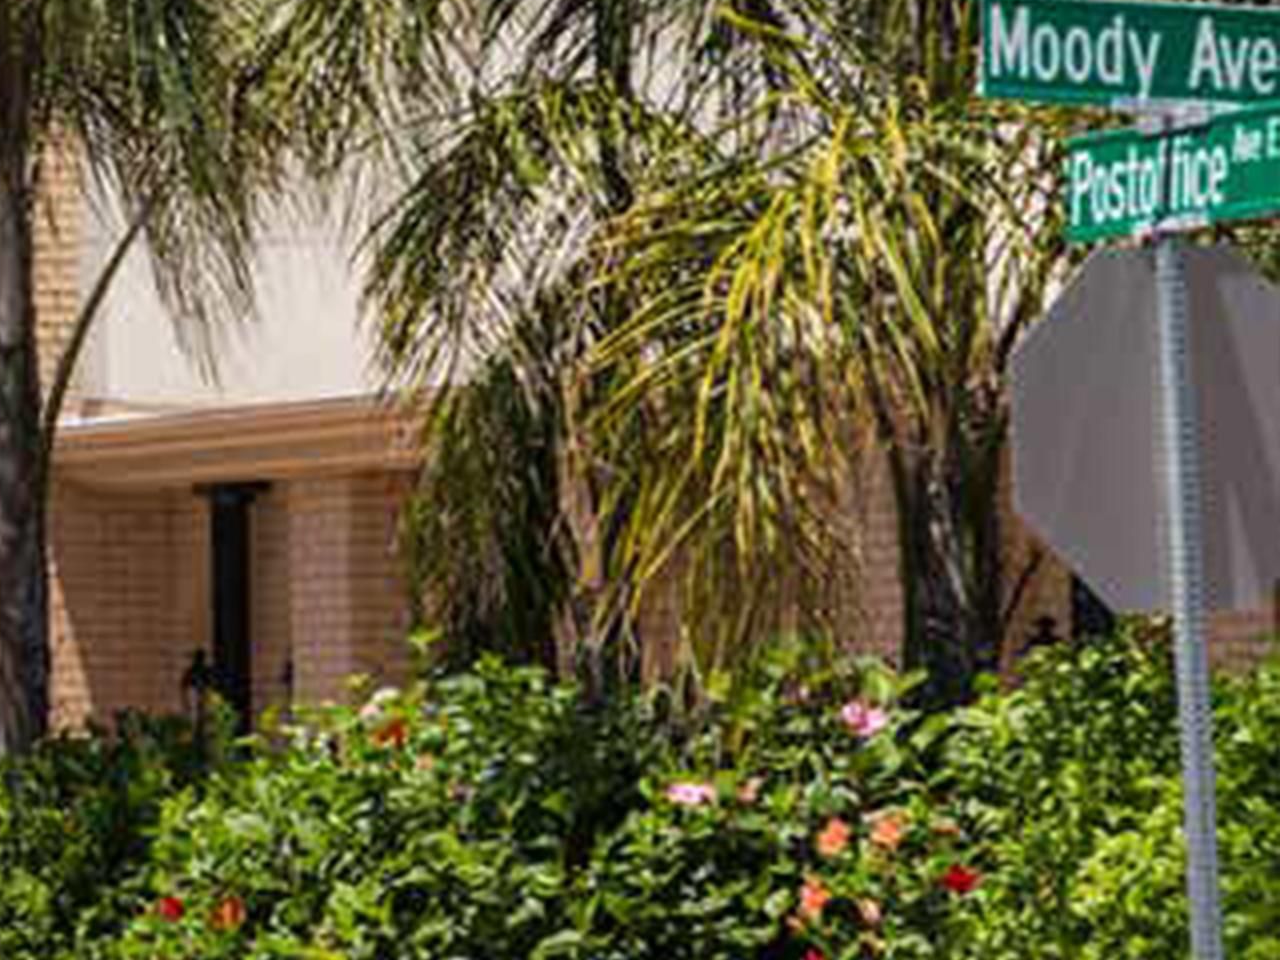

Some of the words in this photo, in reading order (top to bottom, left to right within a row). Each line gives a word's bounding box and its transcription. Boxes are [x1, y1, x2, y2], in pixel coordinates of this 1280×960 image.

[990, 3, 1160, 99] Moody
[1188, 16, 1278, 93] Ave
[1071, 135, 1228, 226] Postoffice
